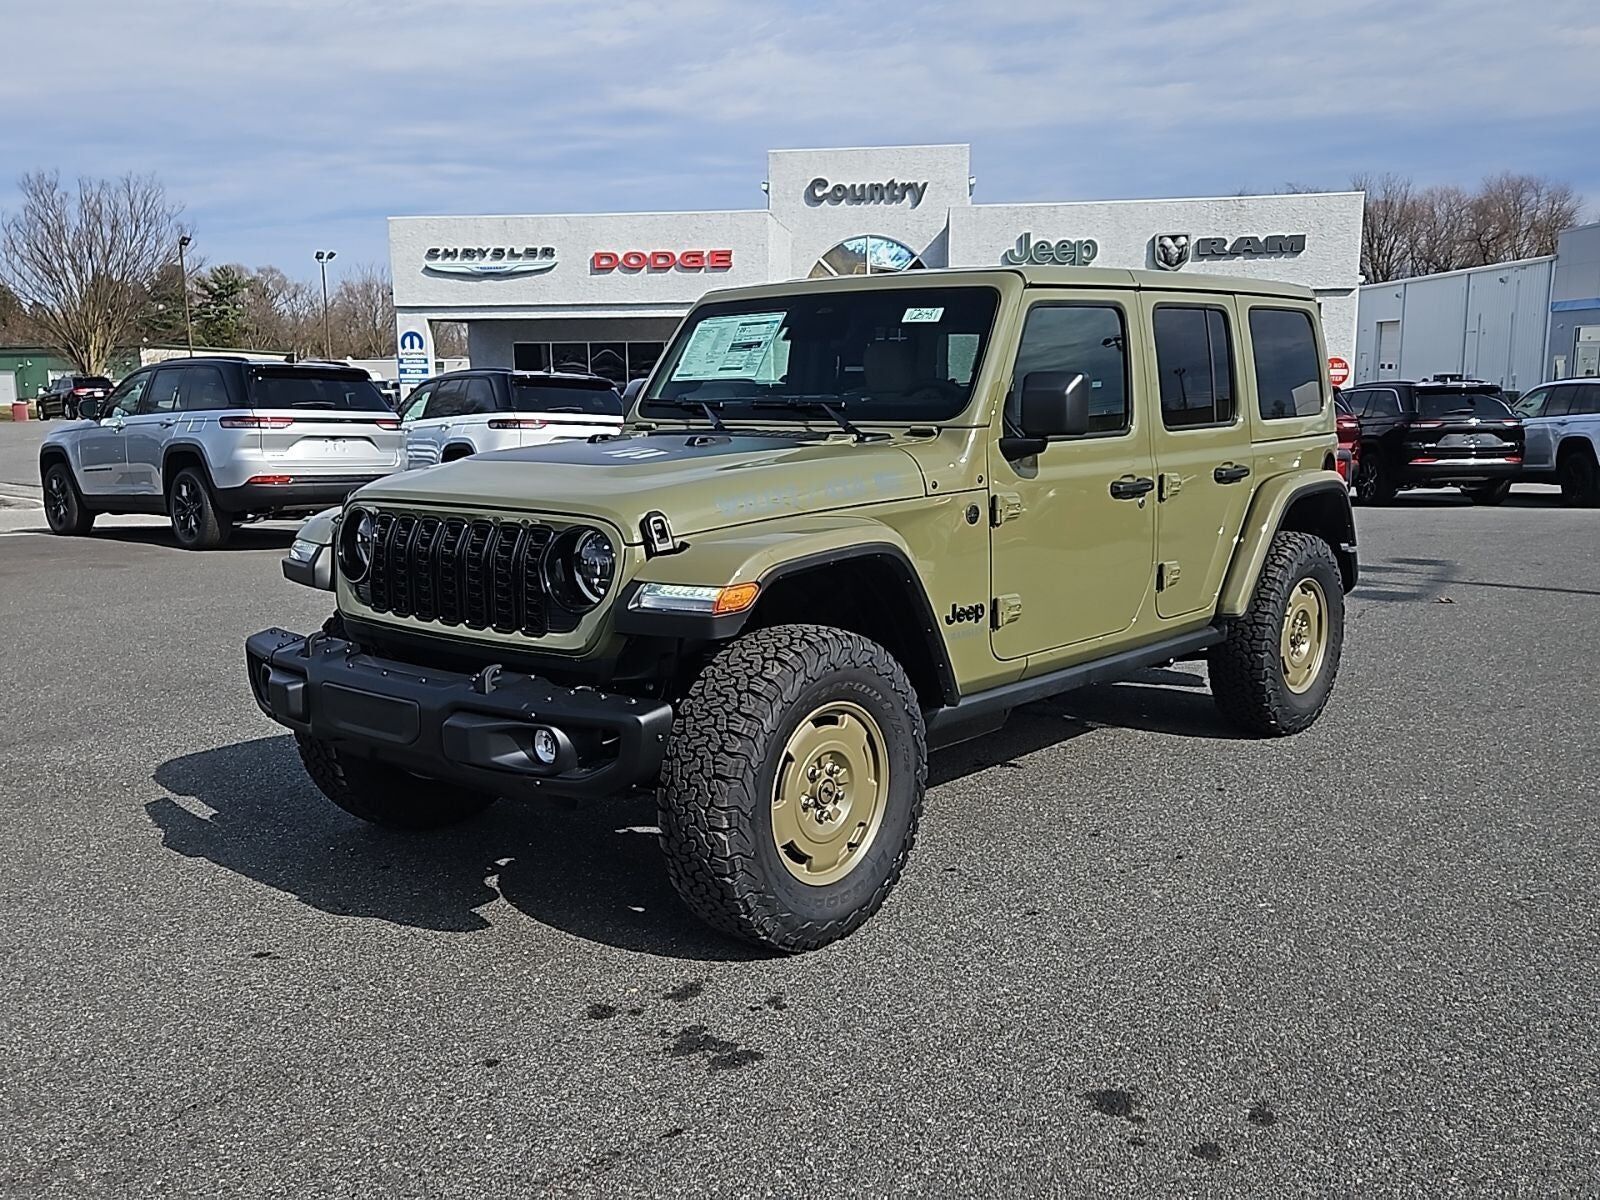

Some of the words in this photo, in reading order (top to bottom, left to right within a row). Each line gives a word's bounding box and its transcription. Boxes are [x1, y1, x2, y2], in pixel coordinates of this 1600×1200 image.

[804, 177, 929, 209] Country
[425, 247, 556, 260] CHRYSLER
[1003, 232, 1098, 266] Jeep
[1193, 234, 1307, 261] RAM
[591, 250, 733, 273] DODGE
[945, 603, 985, 625] Jeep
